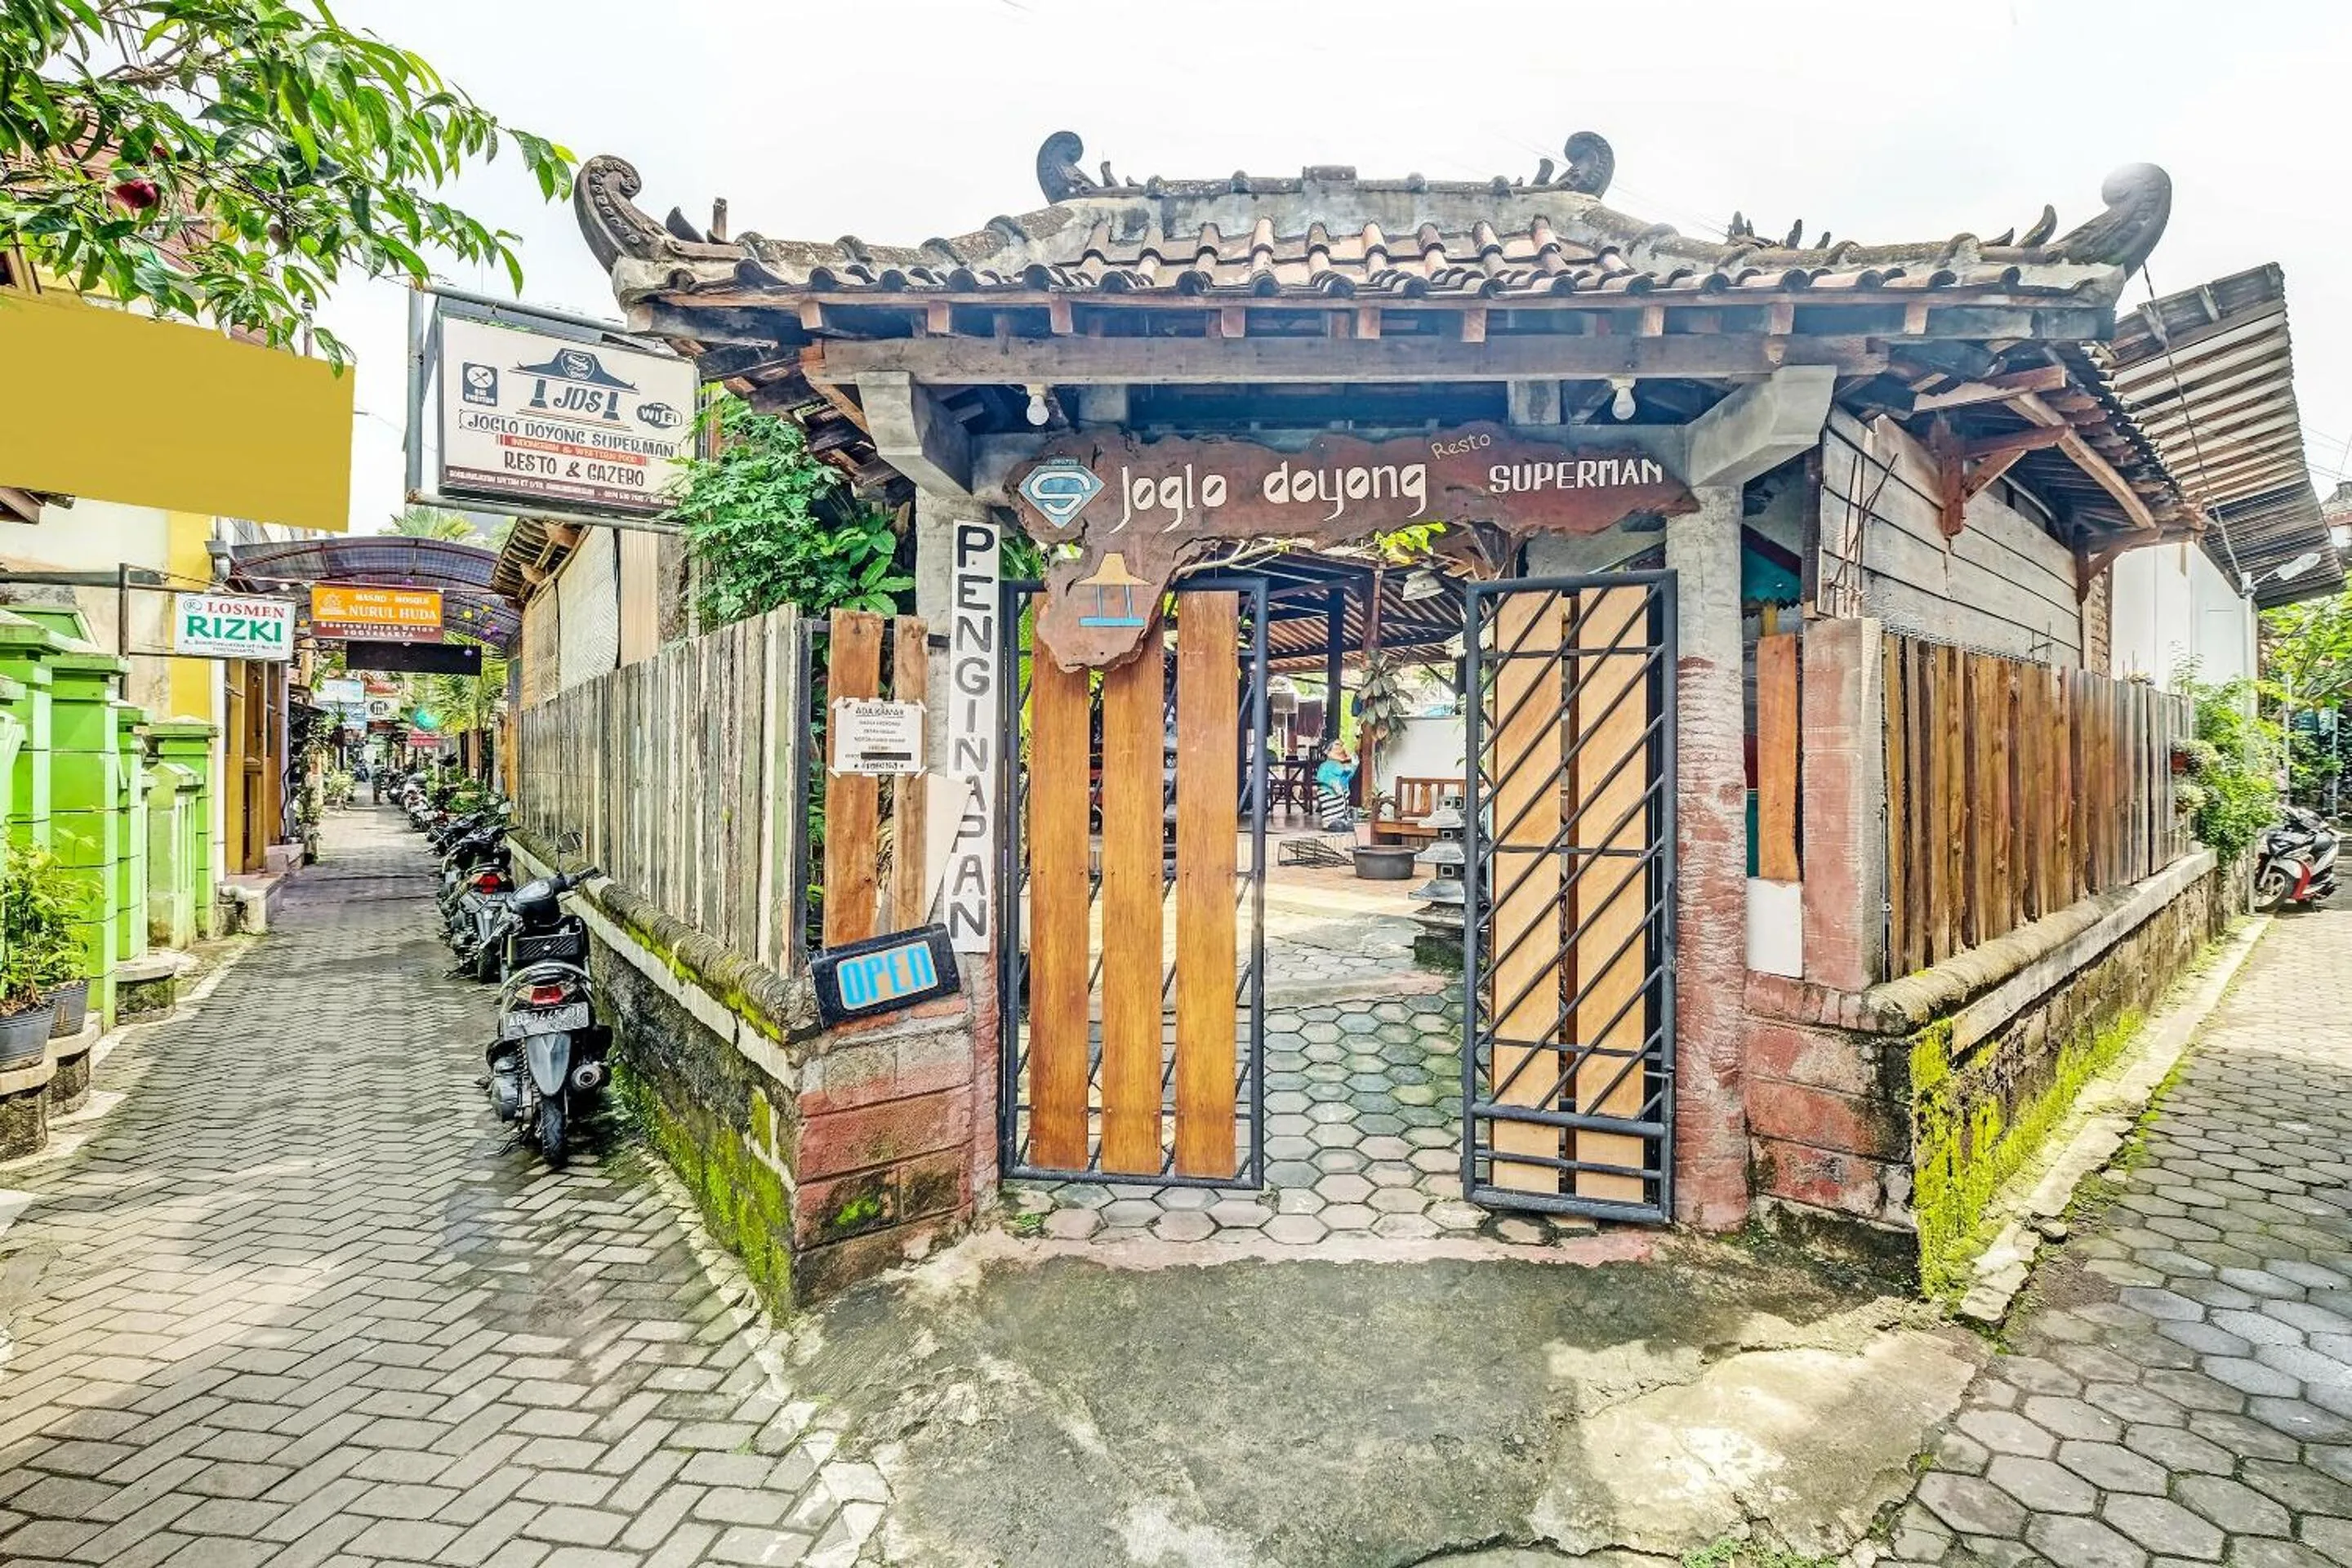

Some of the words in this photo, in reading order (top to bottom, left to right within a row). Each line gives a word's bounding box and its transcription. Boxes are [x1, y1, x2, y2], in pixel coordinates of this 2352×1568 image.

[468, 414, 519, 434] JOGLO
[525, 423, 586, 444] DOYONG
[592, 434, 674, 458] SUPERMAN
[1431, 434, 1490, 460] Resto
[505, 451, 557, 474] RESTO
[566, 461, 581, 479] &
[588, 463, 644, 487] GAZEBO
[1263, 461, 1427, 521] doyong
[1489, 458, 1663, 493] SUPERMAN
[207, 601, 285, 618] LOSMEN
[349, 604, 396, 618] NURUL
[399, 607, 438, 621] HUDA
[186, 615, 283, 643] RIZKI
[950, 525, 995, 939] PENGINAPAN
[841, 945, 933, 1004] OPEN
